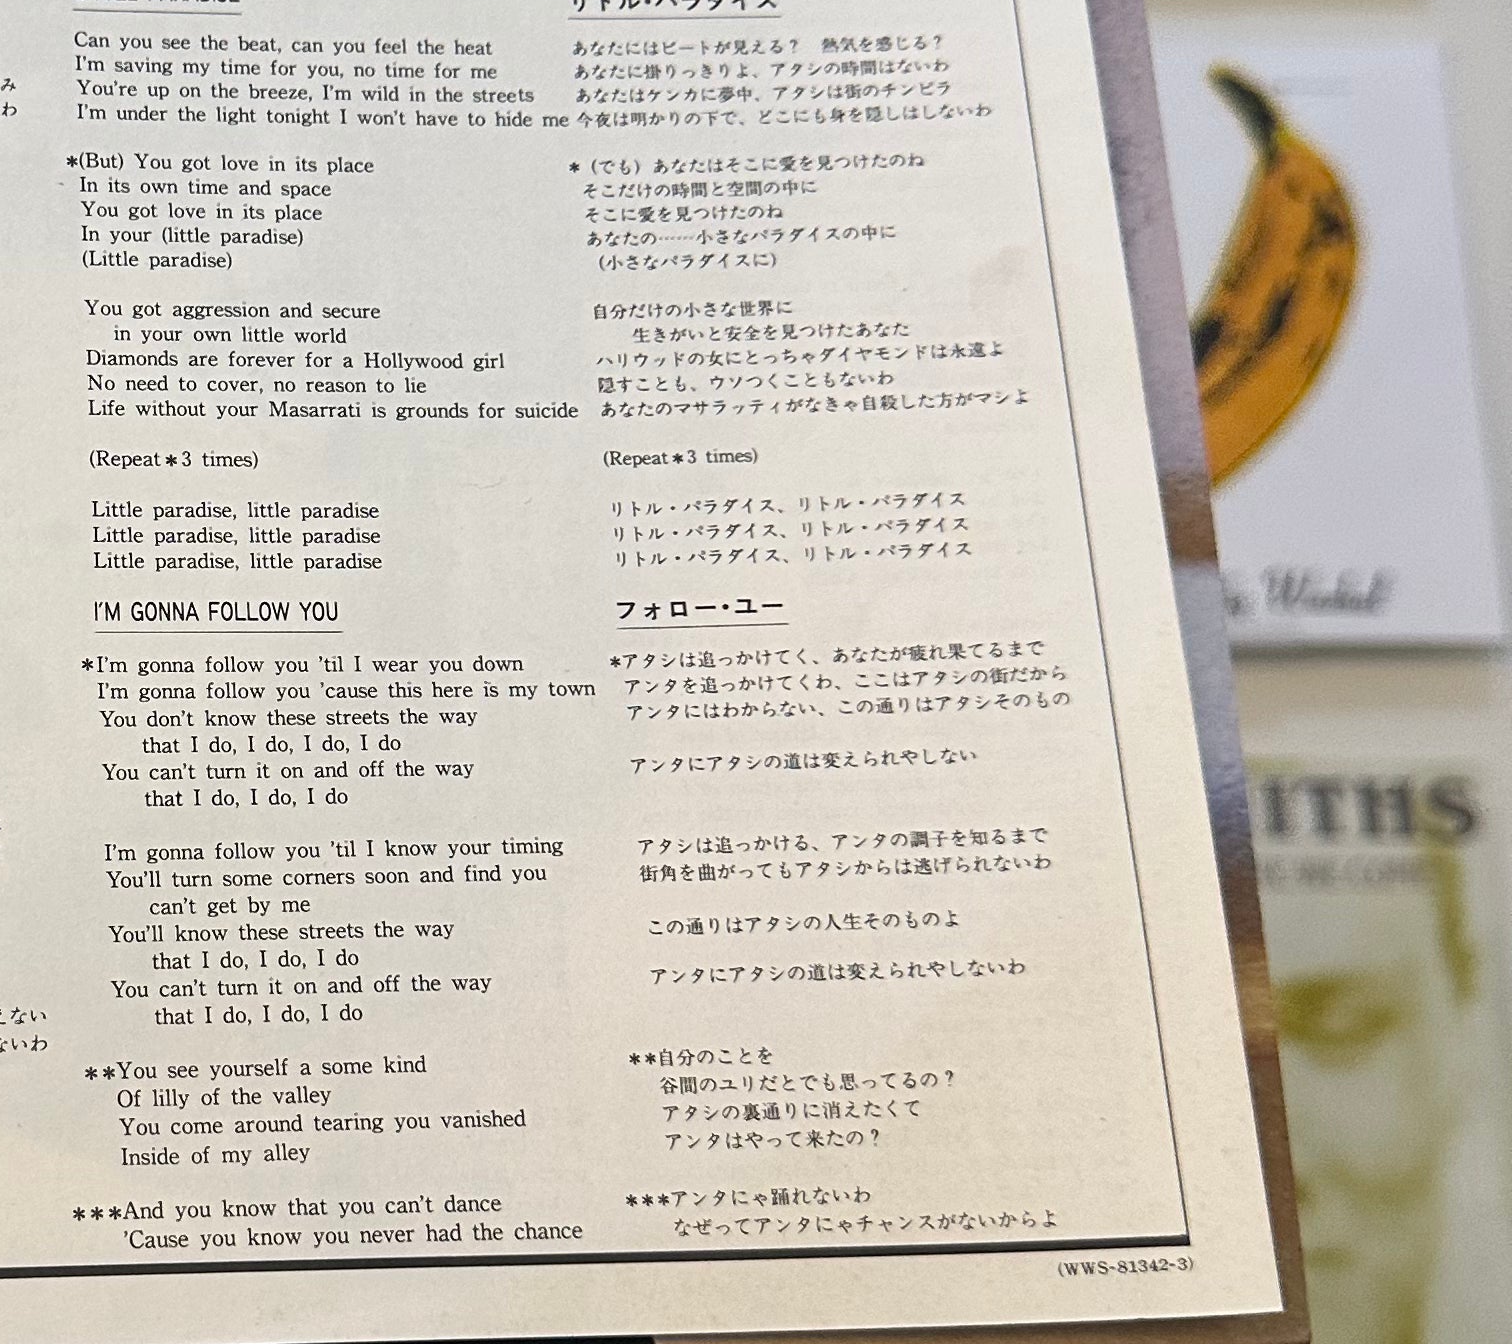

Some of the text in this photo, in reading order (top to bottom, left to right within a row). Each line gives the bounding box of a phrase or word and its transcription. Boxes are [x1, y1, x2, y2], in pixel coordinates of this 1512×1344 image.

[79, 176, 332, 200] In its own time and space
[82, 250, 233, 271] (Little paradise)
[86, 374, 427, 395] No need to cover, no reason to lie
[94, 600, 338, 622] I'M GONNA FOLLOW YOU
[616, 598, 784, 621] フォロー・ユー
[149, 895, 311, 918] can't get by me
[117, 1085, 332, 1110] Of lilly of the valley
[121, 1142, 311, 1167] Inside of my alley
[1057, 1256, 1194, 1278] (WWS-81342-3)
